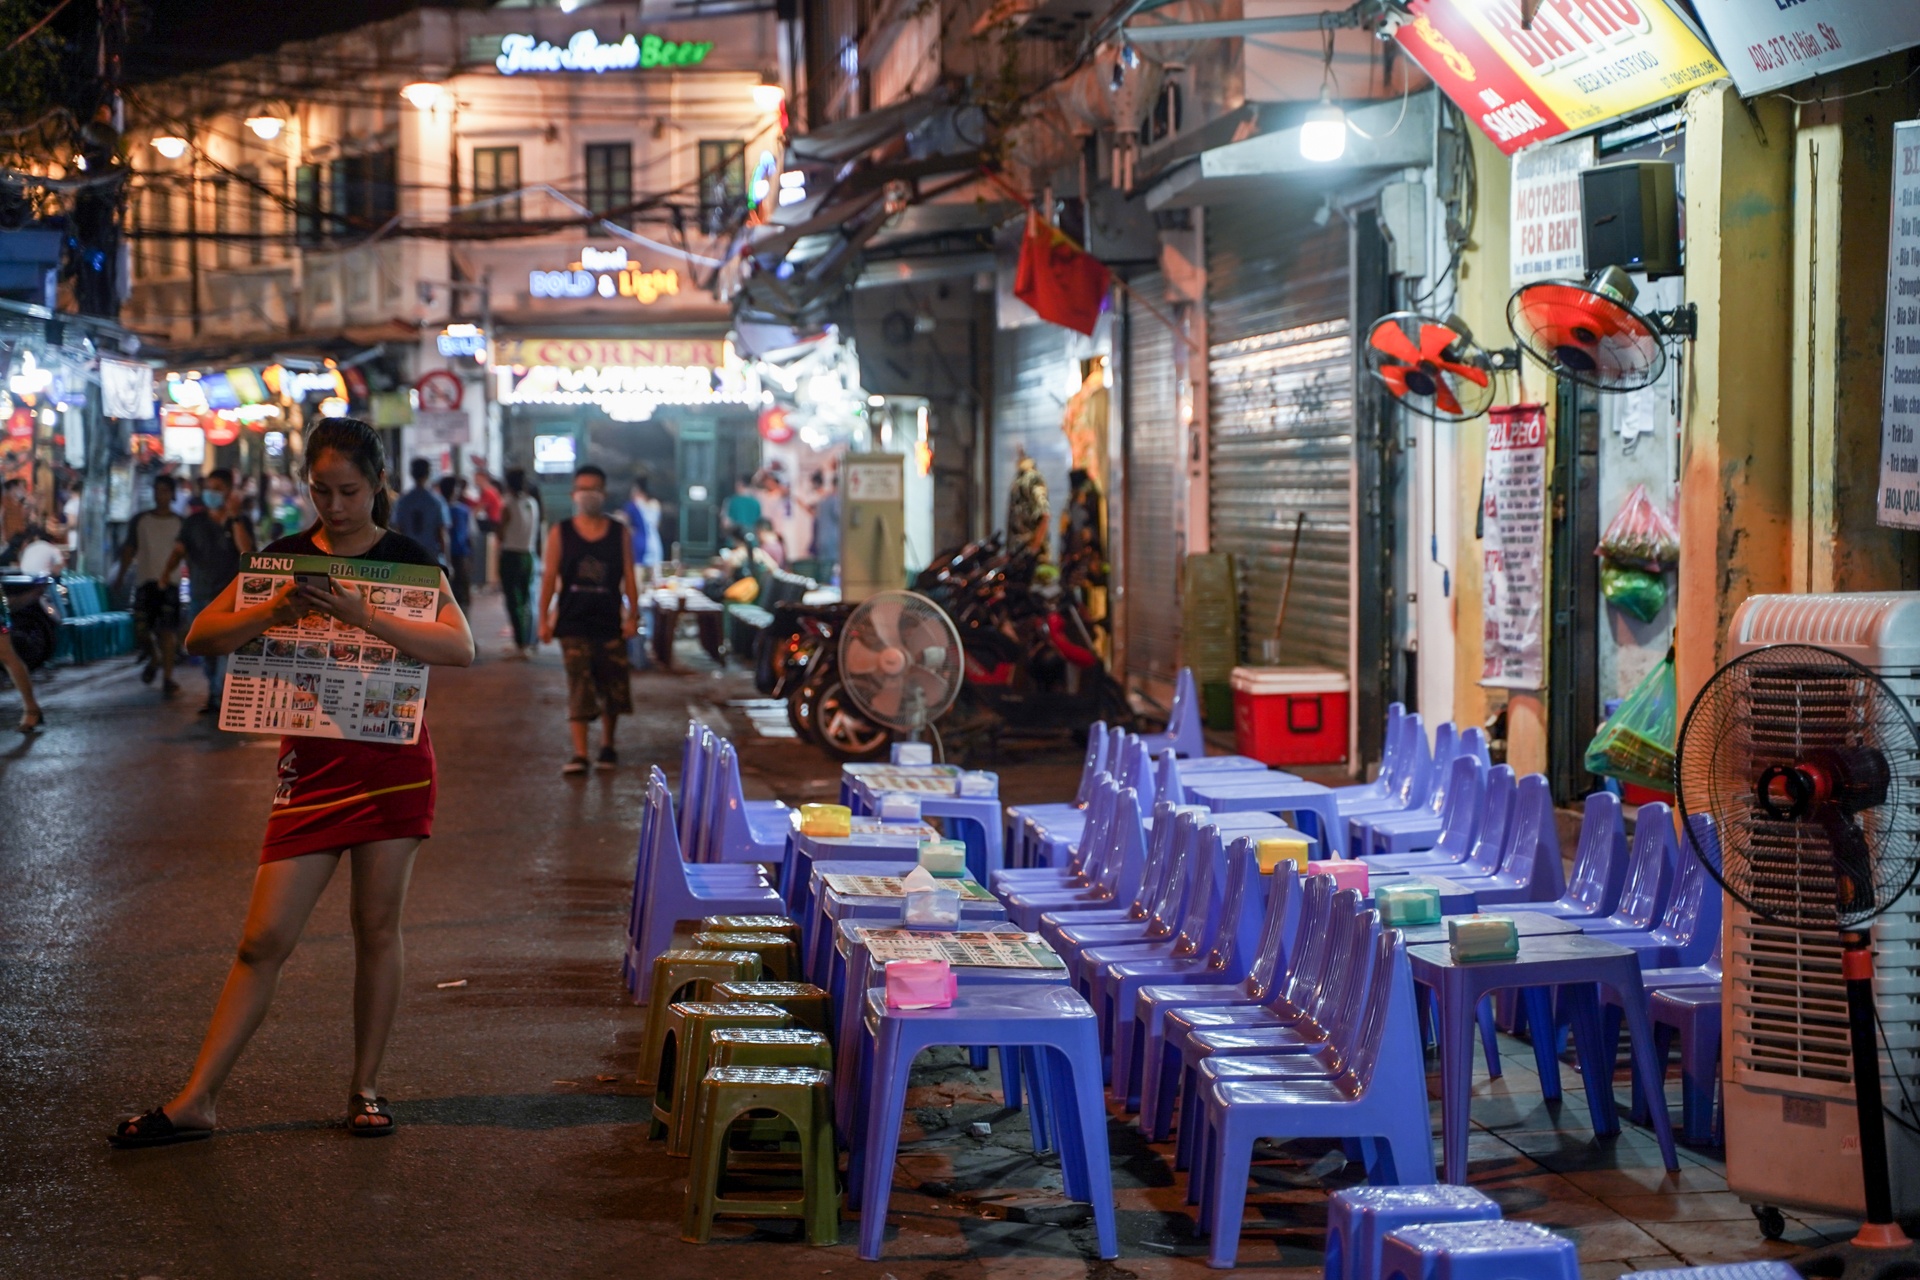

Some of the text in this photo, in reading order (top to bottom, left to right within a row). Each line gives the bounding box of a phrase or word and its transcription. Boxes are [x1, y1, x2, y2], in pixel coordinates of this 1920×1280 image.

[639, 33, 713, 68] Beer
[1482, 99, 1546, 142] SAIGON
[1902, 188, 1911, 207] Bia
[1522, 218, 1578, 256] FOR RENT
[1901, 217, 1911, 237] Bia
[1900, 247, 1910, 266] Bia
[530, 270, 597, 298] BOLD
[1896, 306, 1906, 326] Bia
[539, 340, 714, 364] CORNER
[1895, 336, 1905, 355] Bia
[1892, 424, 1902, 443] Trà
[1890, 453, 1900, 473] Trà
[1885, 487, 1901, 510] HOA
[250, 556, 294, 570] MENU
[330, 563, 355, 577] BIA
[360, 562, 393, 579] PHỐ
